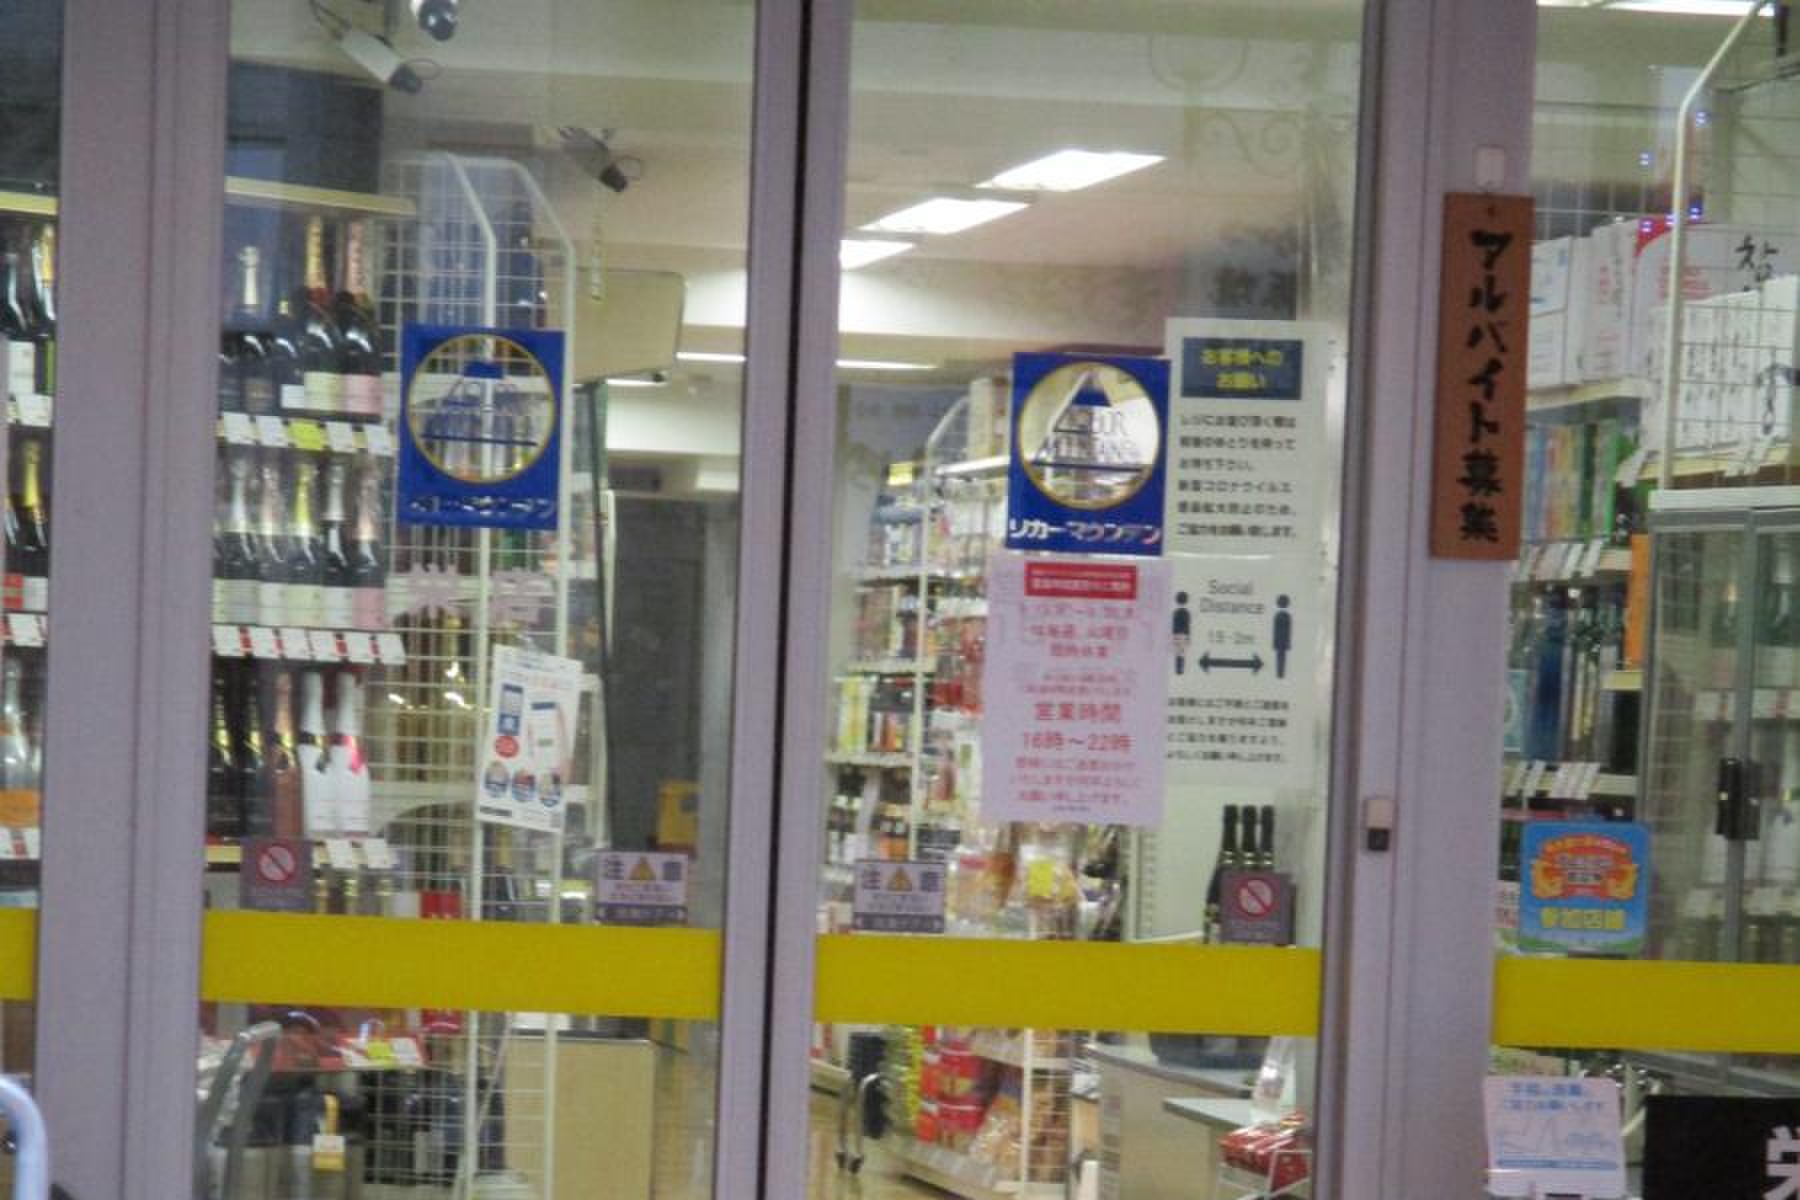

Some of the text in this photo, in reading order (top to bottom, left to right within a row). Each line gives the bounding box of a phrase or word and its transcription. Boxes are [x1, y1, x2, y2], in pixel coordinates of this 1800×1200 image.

[1456, 230, 1513, 542] アルバイト募集
[1009, 518, 1162, 545] リカーマウンテン
[1208, 579, 1253, 595] Social
[1200, 597, 1265, 614] Distance
[1035, 702, 1122, 722] 営業時間
